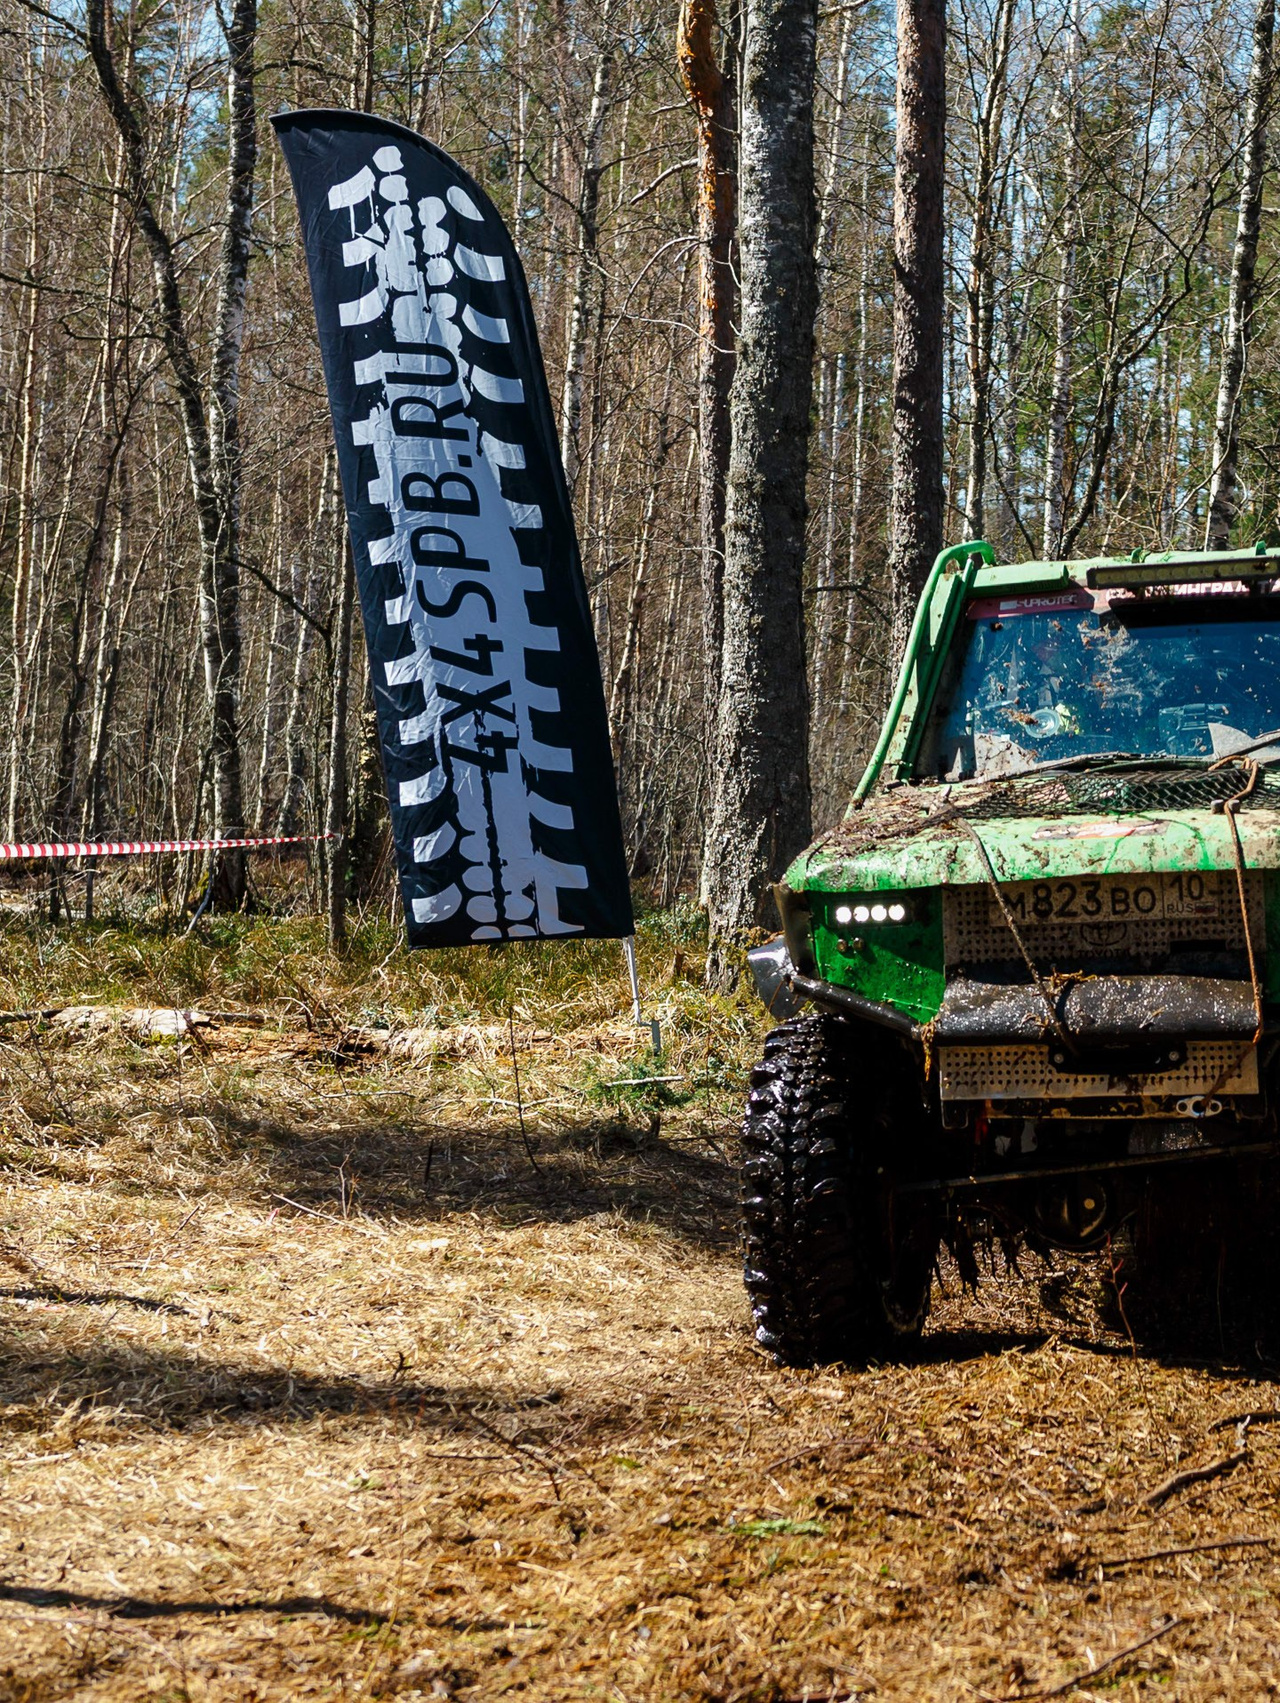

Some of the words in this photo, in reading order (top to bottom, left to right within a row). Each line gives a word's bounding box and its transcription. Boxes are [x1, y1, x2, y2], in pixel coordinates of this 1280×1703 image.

[384, 341, 520, 774] 4X4SPB.RU
[1169, 874, 1205, 901] 10
[1166, 902, 1194, 915] RUS
